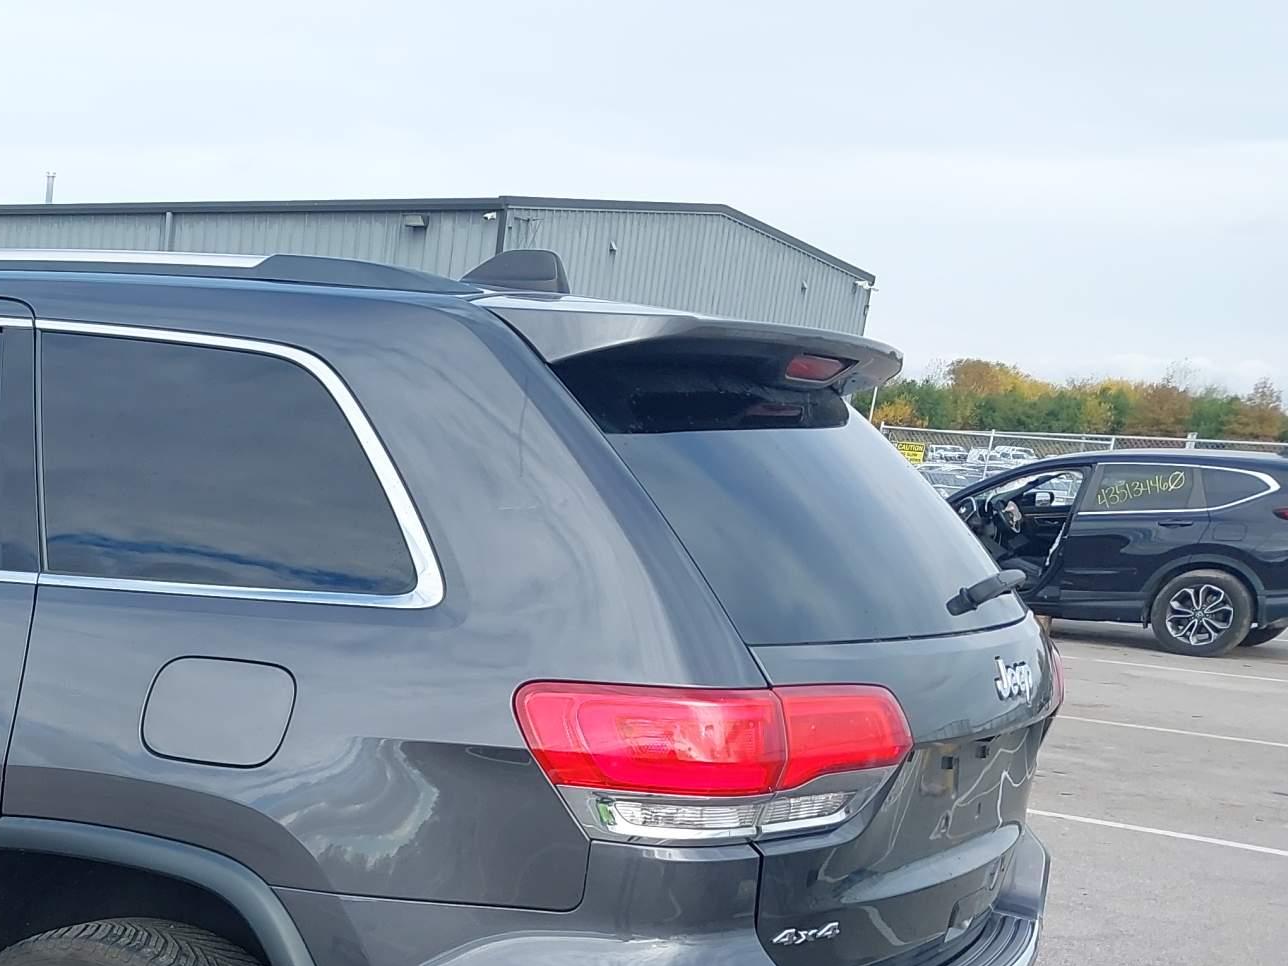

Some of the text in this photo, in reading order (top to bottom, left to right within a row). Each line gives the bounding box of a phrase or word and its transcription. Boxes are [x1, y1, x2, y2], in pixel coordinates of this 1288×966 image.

[897, 443, 924, 452] CAUTION
[995, 656, 1033, 707] Jeep
[772, 921, 841, 946] 4x4
